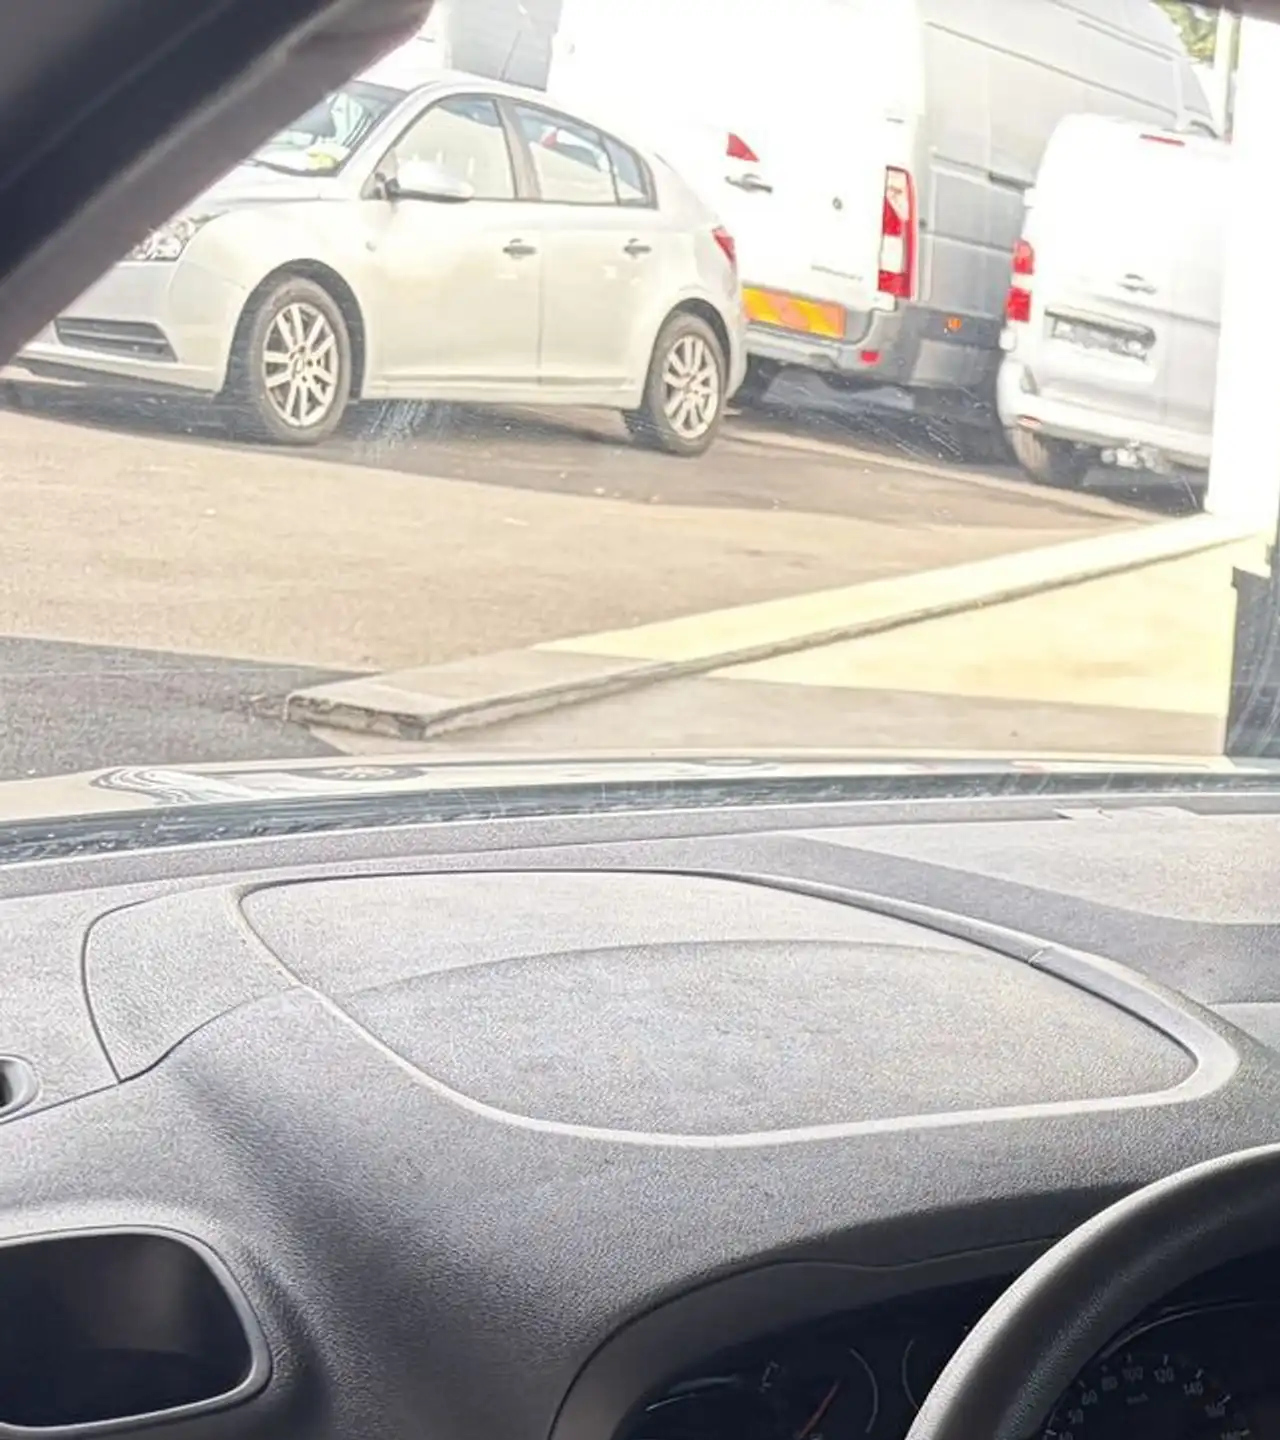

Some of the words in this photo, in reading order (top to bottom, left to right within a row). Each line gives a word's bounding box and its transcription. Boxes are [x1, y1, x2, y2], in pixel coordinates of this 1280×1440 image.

[1154, 1366, 1175, 1384] 120
[1081, 1388, 1098, 1406] 60
[1183, 1381, 1204, 1396] 140
